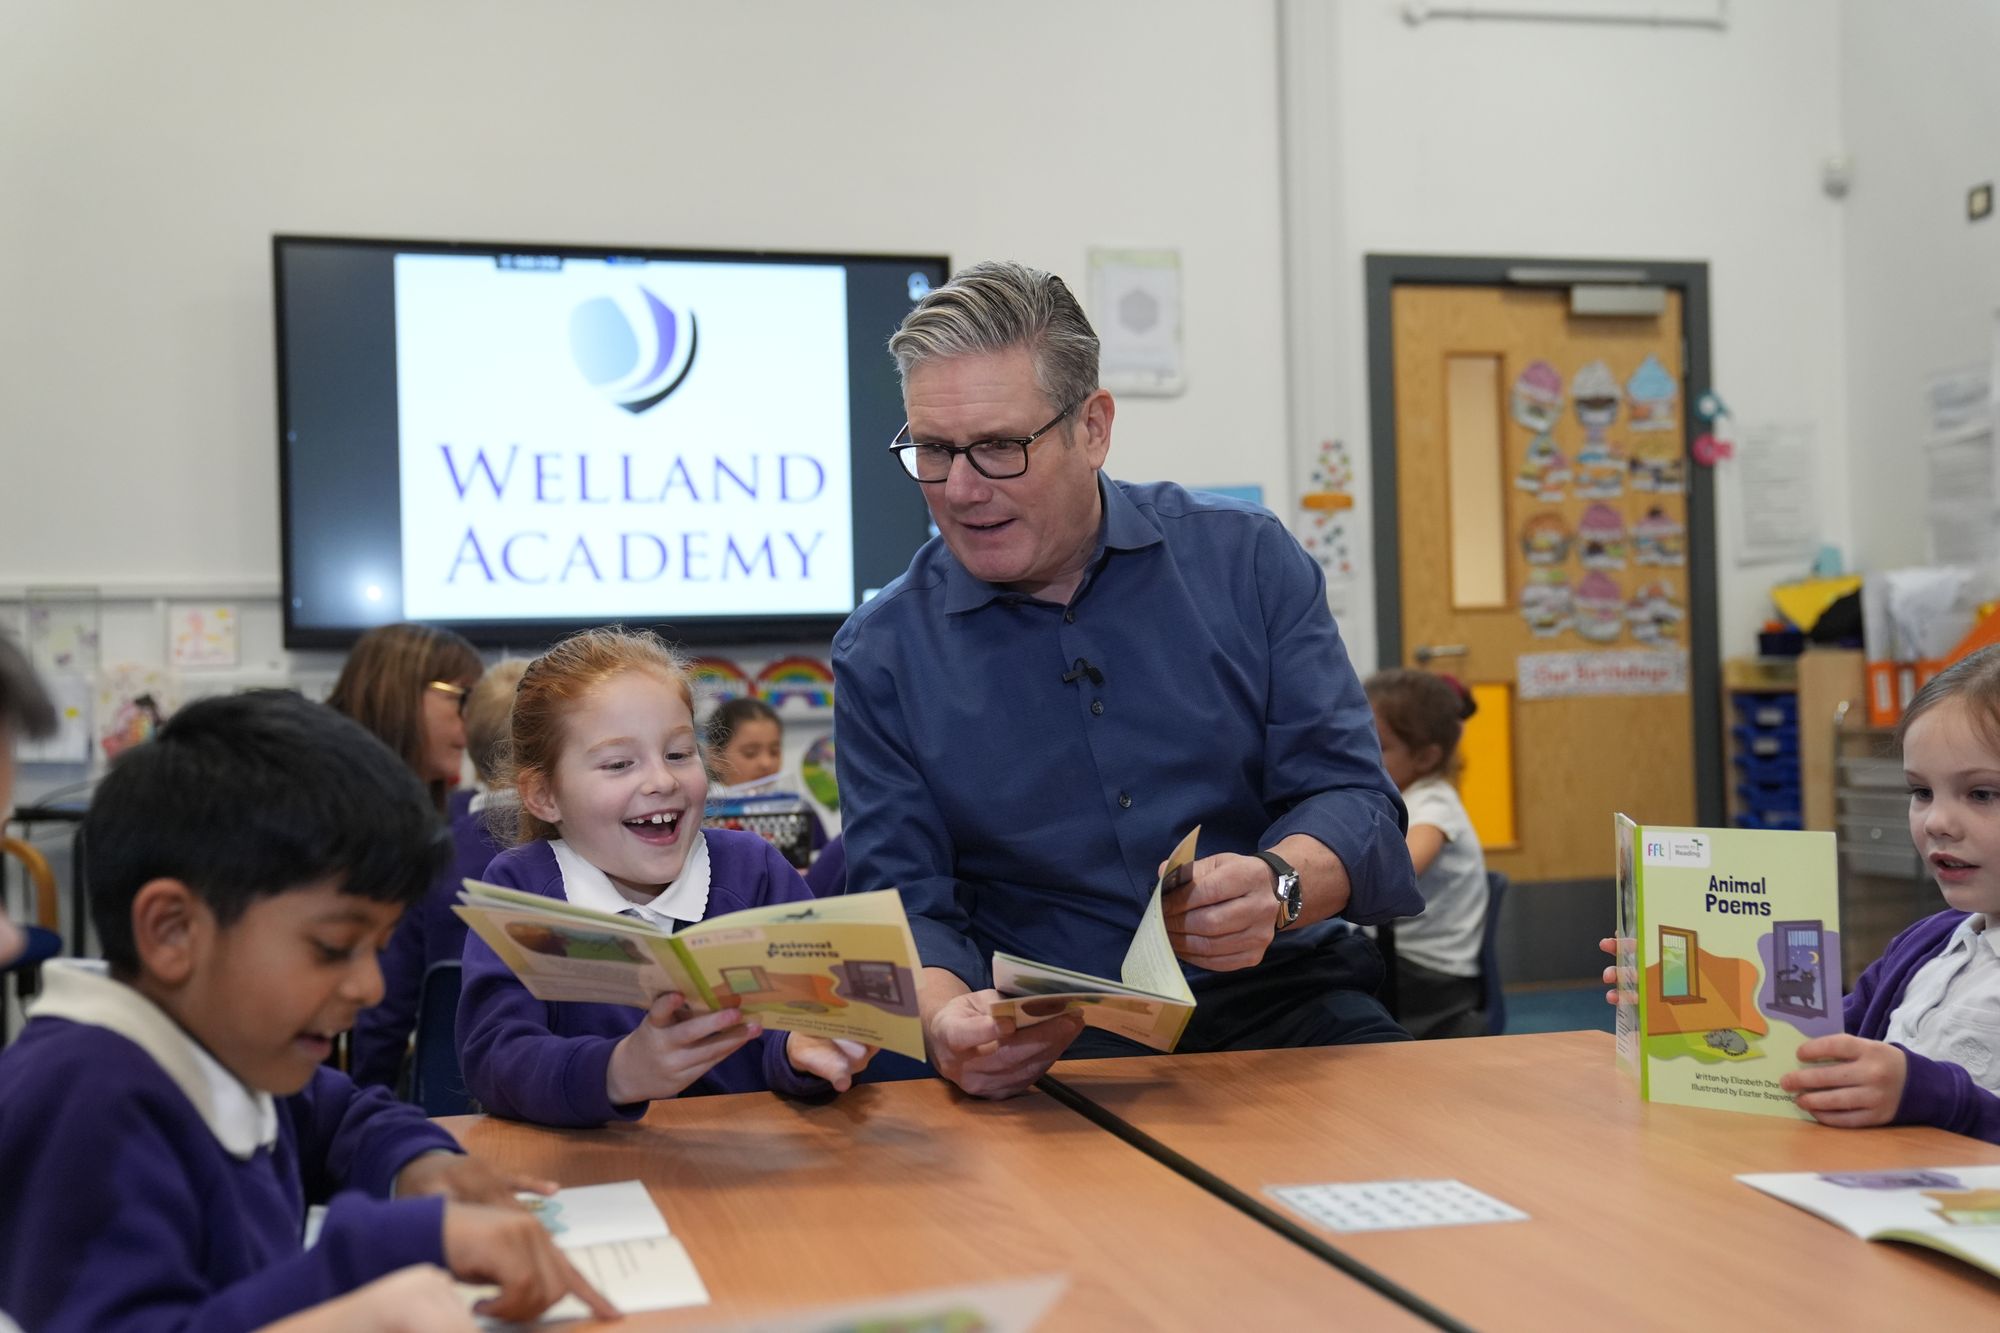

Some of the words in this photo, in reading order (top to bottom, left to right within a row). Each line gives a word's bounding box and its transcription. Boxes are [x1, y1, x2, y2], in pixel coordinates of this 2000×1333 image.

[439, 443, 827, 503] WELLAND
[446, 525, 824, 585] ACADEMY
[1709, 875, 1766, 894] Animal
[1705, 893, 1771, 916] Poems
[1691, 1083, 1728, 1094] Illustrated
[1729, 1087, 1737, 1096] by
[1695, 1072, 1720, 1082] Written
[1721, 1075, 1729, 1084] by
[1730, 1076, 1763, 1087] Elizabeth
